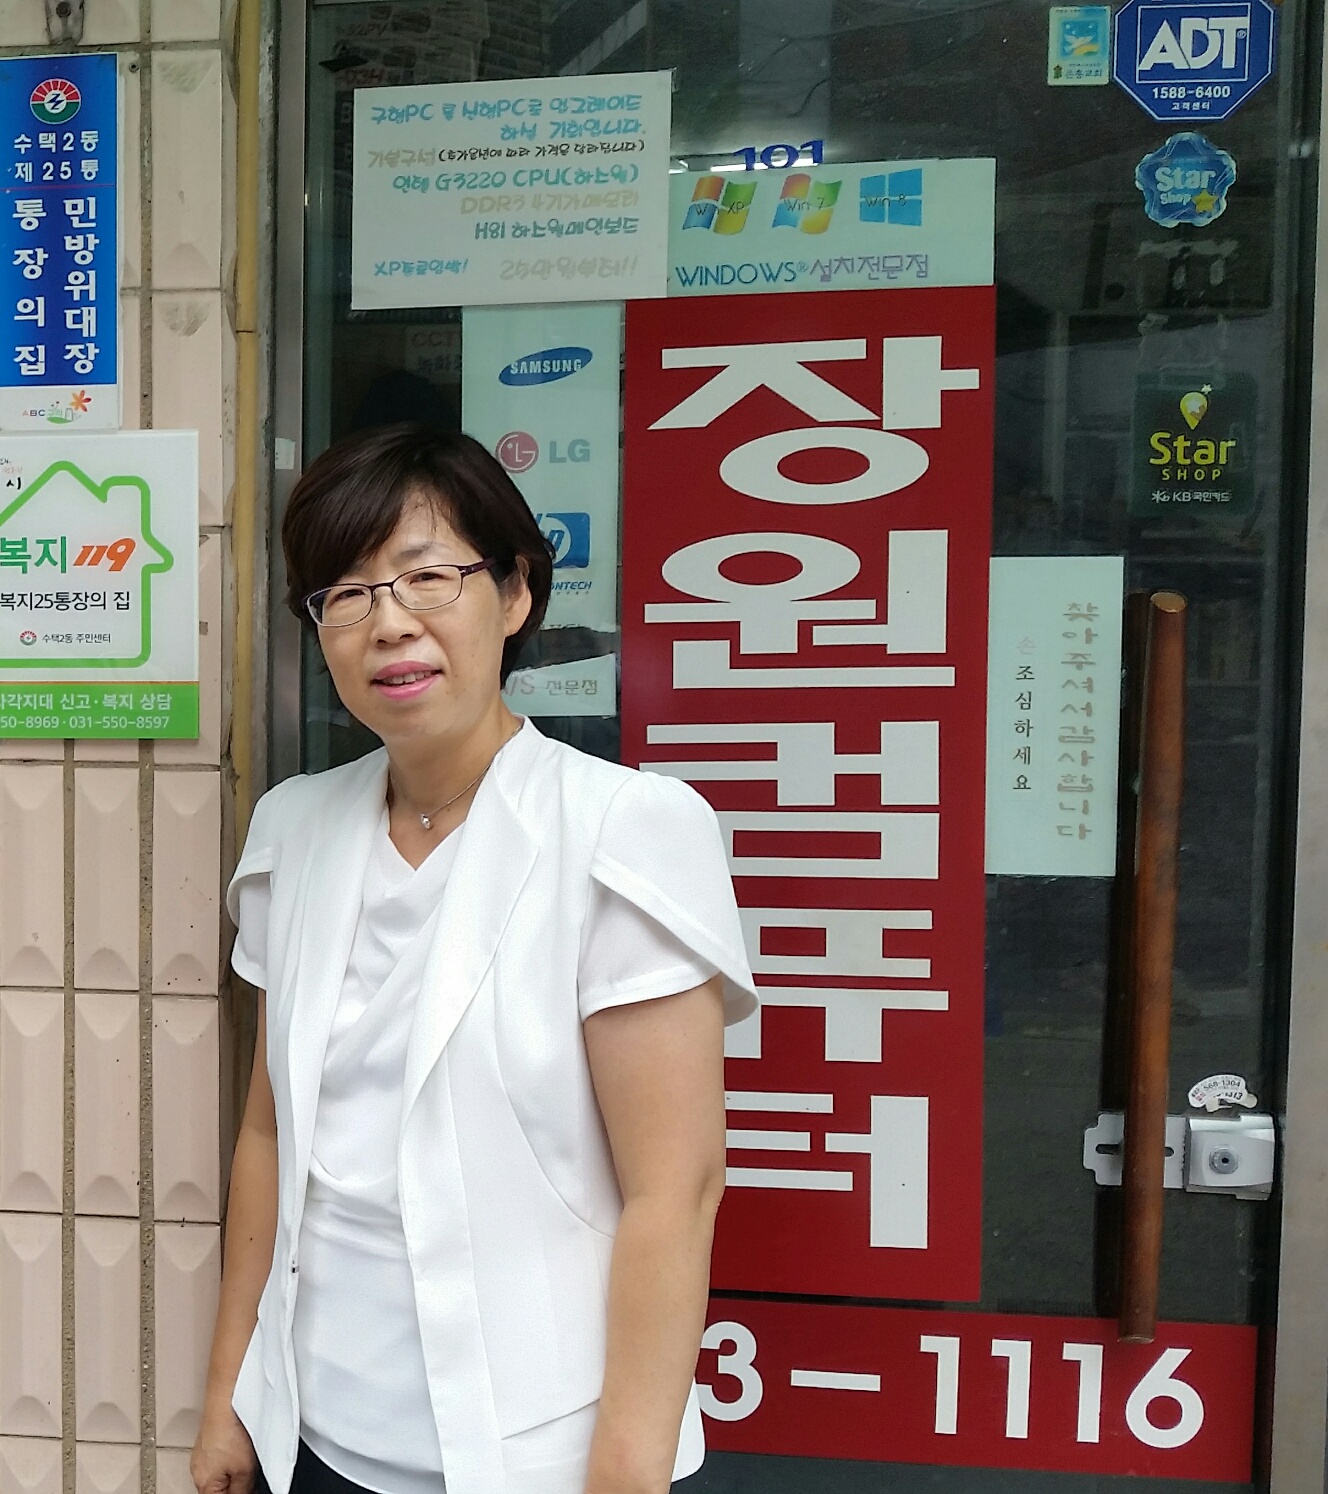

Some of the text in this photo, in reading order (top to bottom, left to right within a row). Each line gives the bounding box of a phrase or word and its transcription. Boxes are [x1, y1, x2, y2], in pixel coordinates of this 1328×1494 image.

[1138, 17, 1249, 70] ADT
[1152, 86, 1231, 99] 1588-6400
[371, 103, 434, 124] 구형PC
[1172, 102, 1210, 111] 고객센터
[733, 139, 824, 171] 101
[435, 171, 507, 191] G3220
[1155, 167, 1216, 191] Star
[460, 194, 525, 214] DDR3
[783, 198, 810, 212] Win
[864, 193, 906, 207] Win 8
[1160, 191, 1192, 205] Shop
[63, 196, 100, 375] 민방위대장
[510, 359, 583, 375] SAMSUNG
[549, 440, 591, 463] LG
[1149, 431, 1237, 465] Star
[1161, 469, 1222, 481] SHOP
[73, 537, 137, 572] 119
[0, 591, 130, 611] 복지25통장의 집
[42, 632, 111, 644] 수택2동 주민센터
[545, 680, 598, 696] 전문점
[140, 693, 172, 711] 상담
